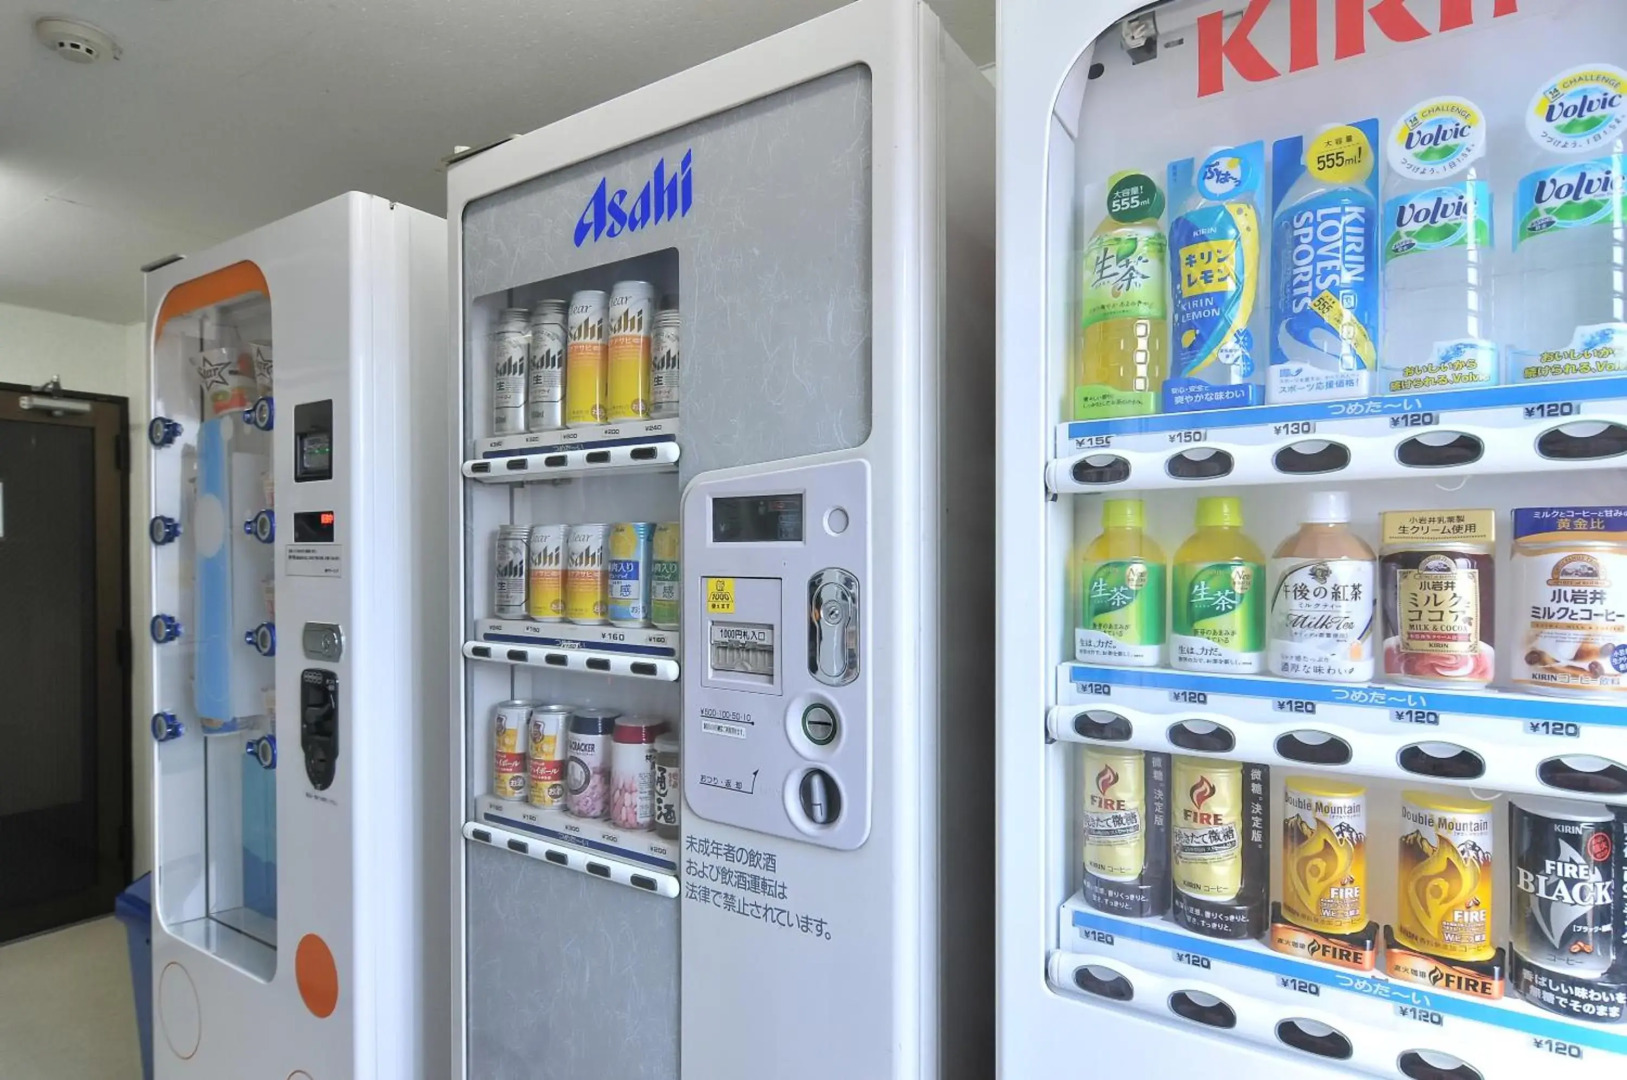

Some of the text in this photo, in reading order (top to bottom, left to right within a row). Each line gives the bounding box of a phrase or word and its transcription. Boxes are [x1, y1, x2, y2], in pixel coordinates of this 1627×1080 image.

[1545, 92, 1622, 123] Volvic
[1405, 122, 1471, 150] Volvic
[573, 147, 692, 248] Asahi
[1193, 227, 1217, 237] KIRIN
[1315, 207, 1343, 290] LOVES
[1344, 207, 1365, 281] KIRIN
[1185, 249, 1231, 267] キリン
[1293, 211, 1315, 313] SPORTS
[1091, 247, 1151, 291] 生茶
[1187, 268, 1232, 287] レモン
[1181, 297, 1214, 311] KIRIN
[1181, 307, 1221, 323] LEMON
[1174, 391, 1246, 405] 爽やかな味わい
[1527, 403, 1573, 417] ¥120
[1391, 413, 1433, 427] ¥120
[1169, 431, 1202, 442] ¥150
[1274, 422, 1311, 435] ¥130
[1398, 523, 1477, 535] 生クリーム使用
[1556, 518, 1605, 530] 黄金比
[1091, 578, 1132, 607] 生茶
[1282, 583, 1362, 601] 午後の紅茶
[1419, 581, 1456, 591] 小岩井
[1191, 581, 1237, 612] 生茶
[1409, 593, 1462, 607] ミルク
[1550, 589, 1606, 605] 小岩井
[1408, 609, 1466, 622] ココア
[1531, 606, 1625, 622] ミルクとコーヒー
[601, 633, 625, 642] ¥160
[720, 629, 766, 641] 1000円札入口
[1532, 673, 1557, 681] KIRIN
[1081, 684, 1110, 694] ¥120
[1174, 692, 1206, 704] ¥120
[1277, 700, 1316, 714] ¥120
[1395, 711, 1438, 725] ¥120
[1530, 722, 1577, 737] ¥120
[1091, 795, 1126, 811] FIRE
[1250, 769, 1263, 848] 微糖。決定版。
[1315, 802, 1361, 814] Mountain
[1183, 809, 1223, 825] FIRE
[1402, 806, 1488, 832] Double Mountain
[1554, 824, 1583, 834] KIRIN
[686, 835, 776, 873] 未成年者の飲酒
[1545, 859, 1590, 880] FIRE
[686, 859, 787, 900] および飲酒運転は
[1516, 866, 1614, 906] BLACK
[1330, 887, 1360, 899] FIRE
[685, 881, 831, 940] 法律で禁止されています。
[1454, 909, 1486, 922] FIRE
[1085, 930, 1114, 945] ¥120
[1177, 952, 1210, 969] ¥120
[1321, 944, 1363, 964] FIRE
[1281, 977, 1320, 996] ¥120
[1445, 973, 1492, 995] FIRE
[1400, 1006, 1443, 1026] ¥120
[1533, 1038, 1581, 1058] ¥120
